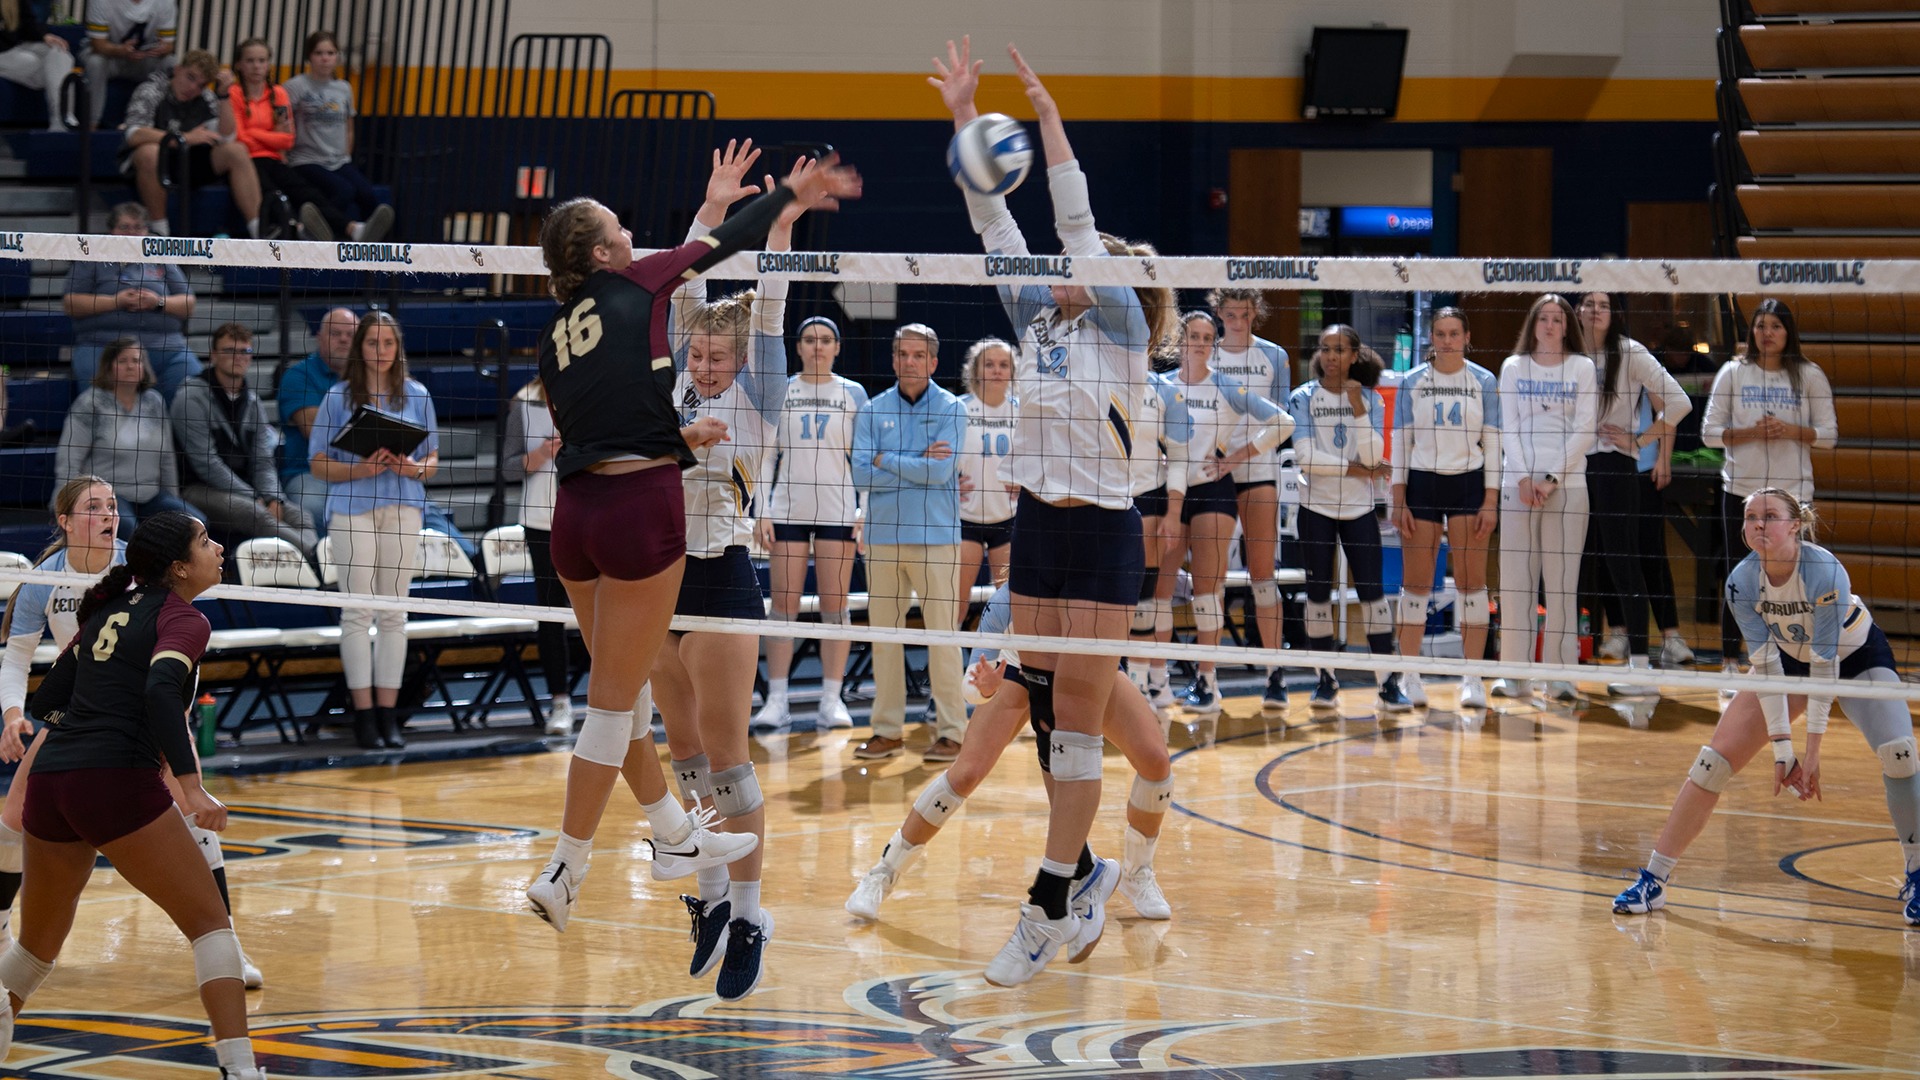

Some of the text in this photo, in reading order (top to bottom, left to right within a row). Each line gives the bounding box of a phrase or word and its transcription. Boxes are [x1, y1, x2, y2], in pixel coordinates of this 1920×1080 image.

[142, 237, 213, 258] CEDARVILLE
[337, 242, 412, 264] CEDARVILLE
[757, 252, 840, 274] CEDARVILLE
[985, 256, 1073, 278] CEDARVILLE
[1227, 259, 1319, 282] CEDARVILLE
[1483, 261, 1582, 284] CEDARVILLE
[1758, 261, 1865, 285] CEDARVILLE
[552, 298, 603, 372] 16
[1434, 401, 1462, 426] 14
[801, 413, 830, 440] 17
[1333, 423, 1348, 449] 8
[981, 433, 1009, 457] 10
[92, 611, 130, 662] 6
[1768, 622, 1810, 643] 13
